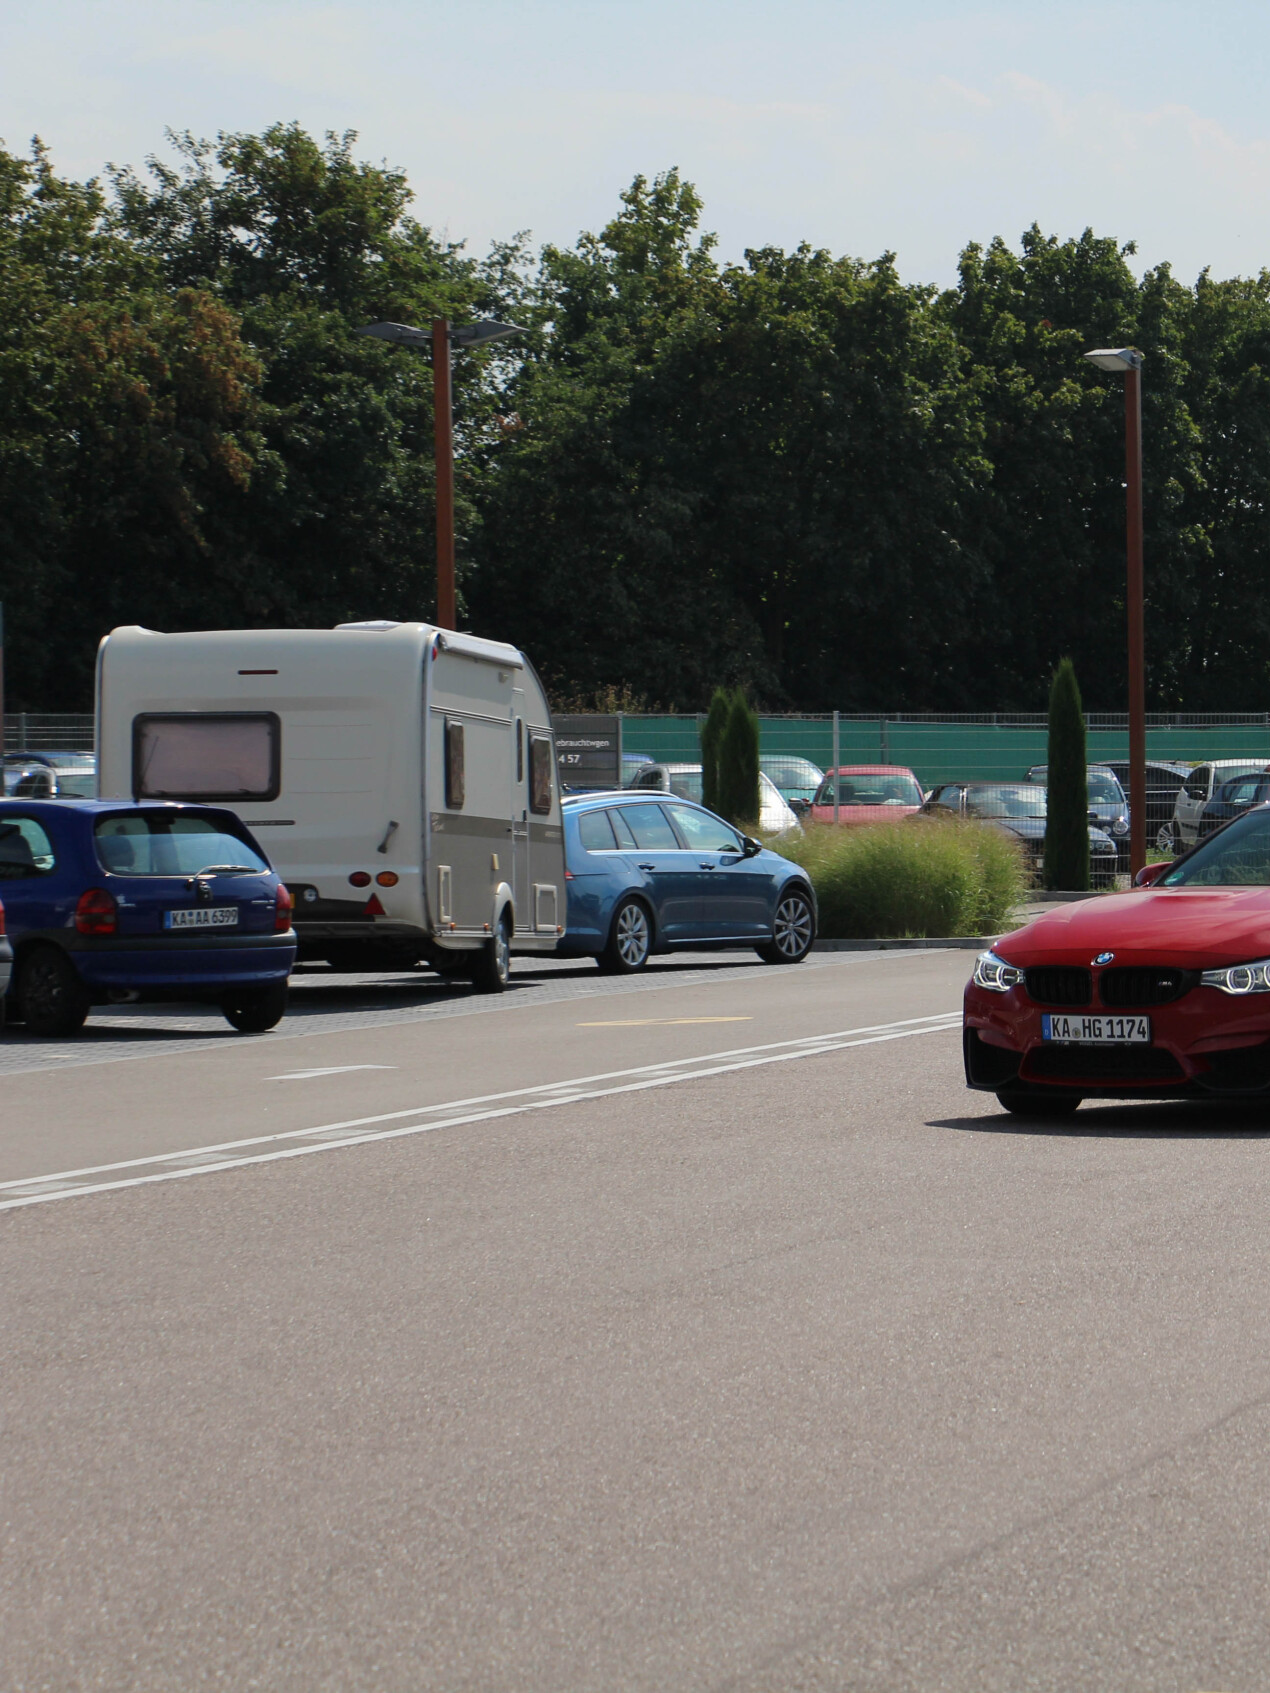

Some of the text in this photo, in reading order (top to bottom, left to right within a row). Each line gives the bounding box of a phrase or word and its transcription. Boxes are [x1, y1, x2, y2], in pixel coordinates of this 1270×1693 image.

[567, 754, 581, 763] 57
[172, 909, 237, 926] KA AA 6399
[1052, 1017, 1070, 1037] KA
[1082, 1018, 1102, 1038] HG
[1106, 1019, 1146, 1039] 1174
